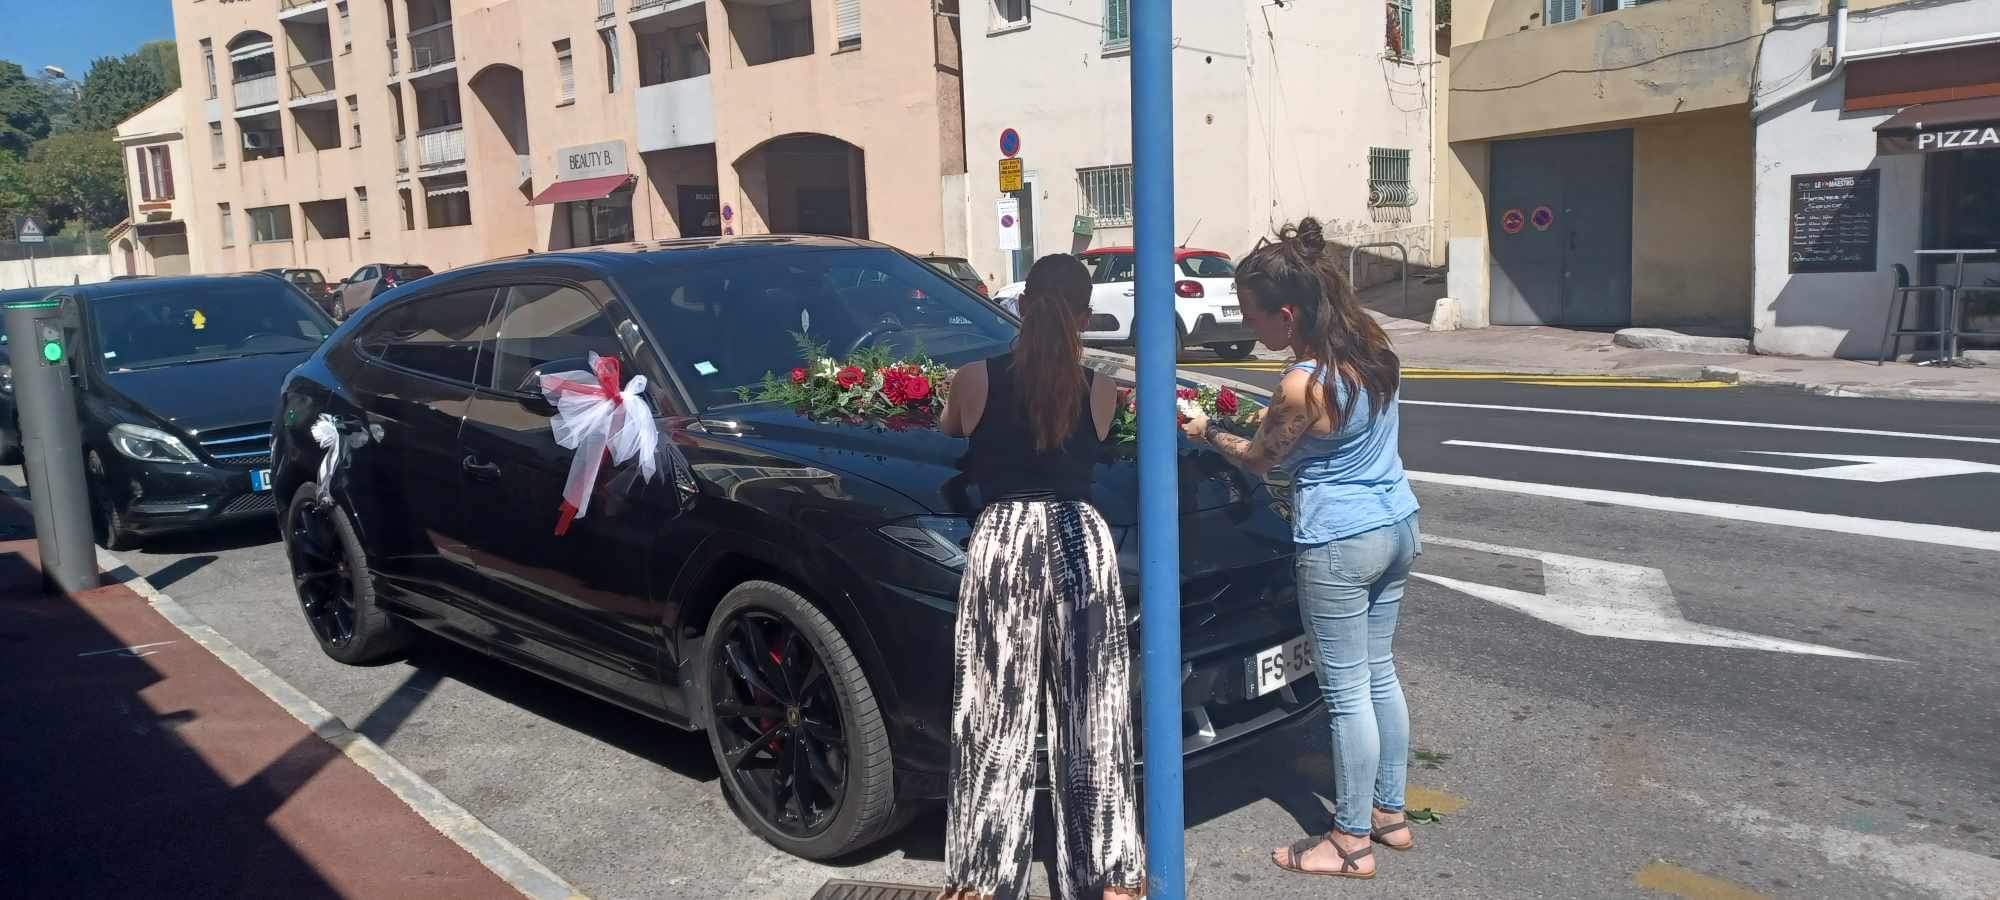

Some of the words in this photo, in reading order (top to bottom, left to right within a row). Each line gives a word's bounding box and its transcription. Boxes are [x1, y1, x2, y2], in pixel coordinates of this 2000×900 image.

[1918, 127, 2000, 150] PIZZA
[569, 152, 601, 169] BEAUTY
[604, 150, 613, 165] B.
[1829, 179, 1855, 187] MAESTRO
